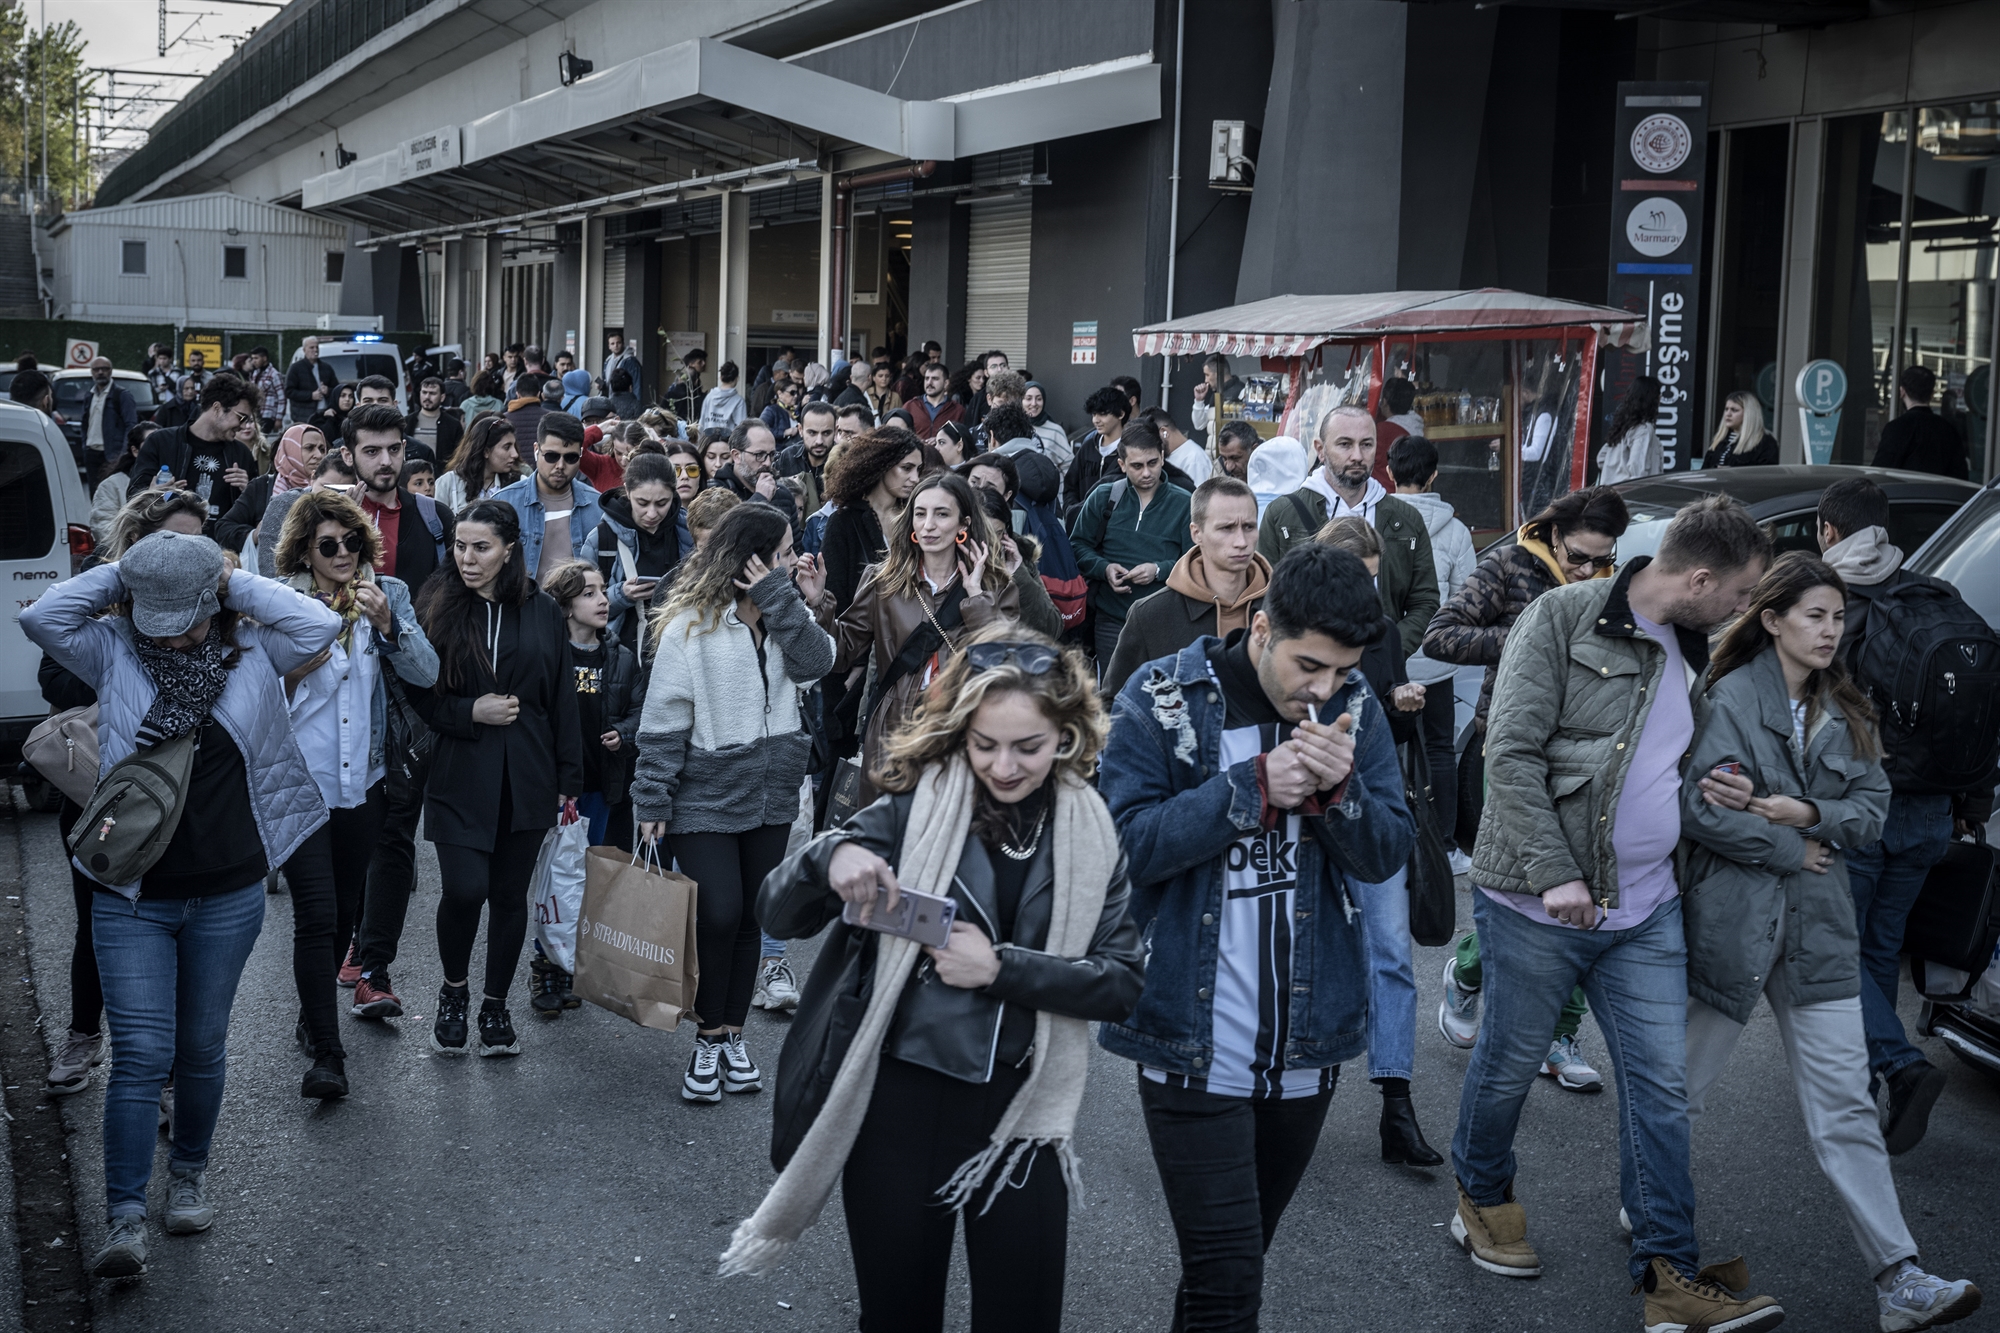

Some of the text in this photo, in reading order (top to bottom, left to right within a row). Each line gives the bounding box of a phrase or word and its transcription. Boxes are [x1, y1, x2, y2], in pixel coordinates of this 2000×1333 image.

[1634, 233, 1681, 246] Marmaray
[1816, 369, 1833, 396] P
[13, 570, 58, 581] nemo
[593, 921, 675, 965] STRADIVARIUS
[1903, 1288, 1913, 1300] N
